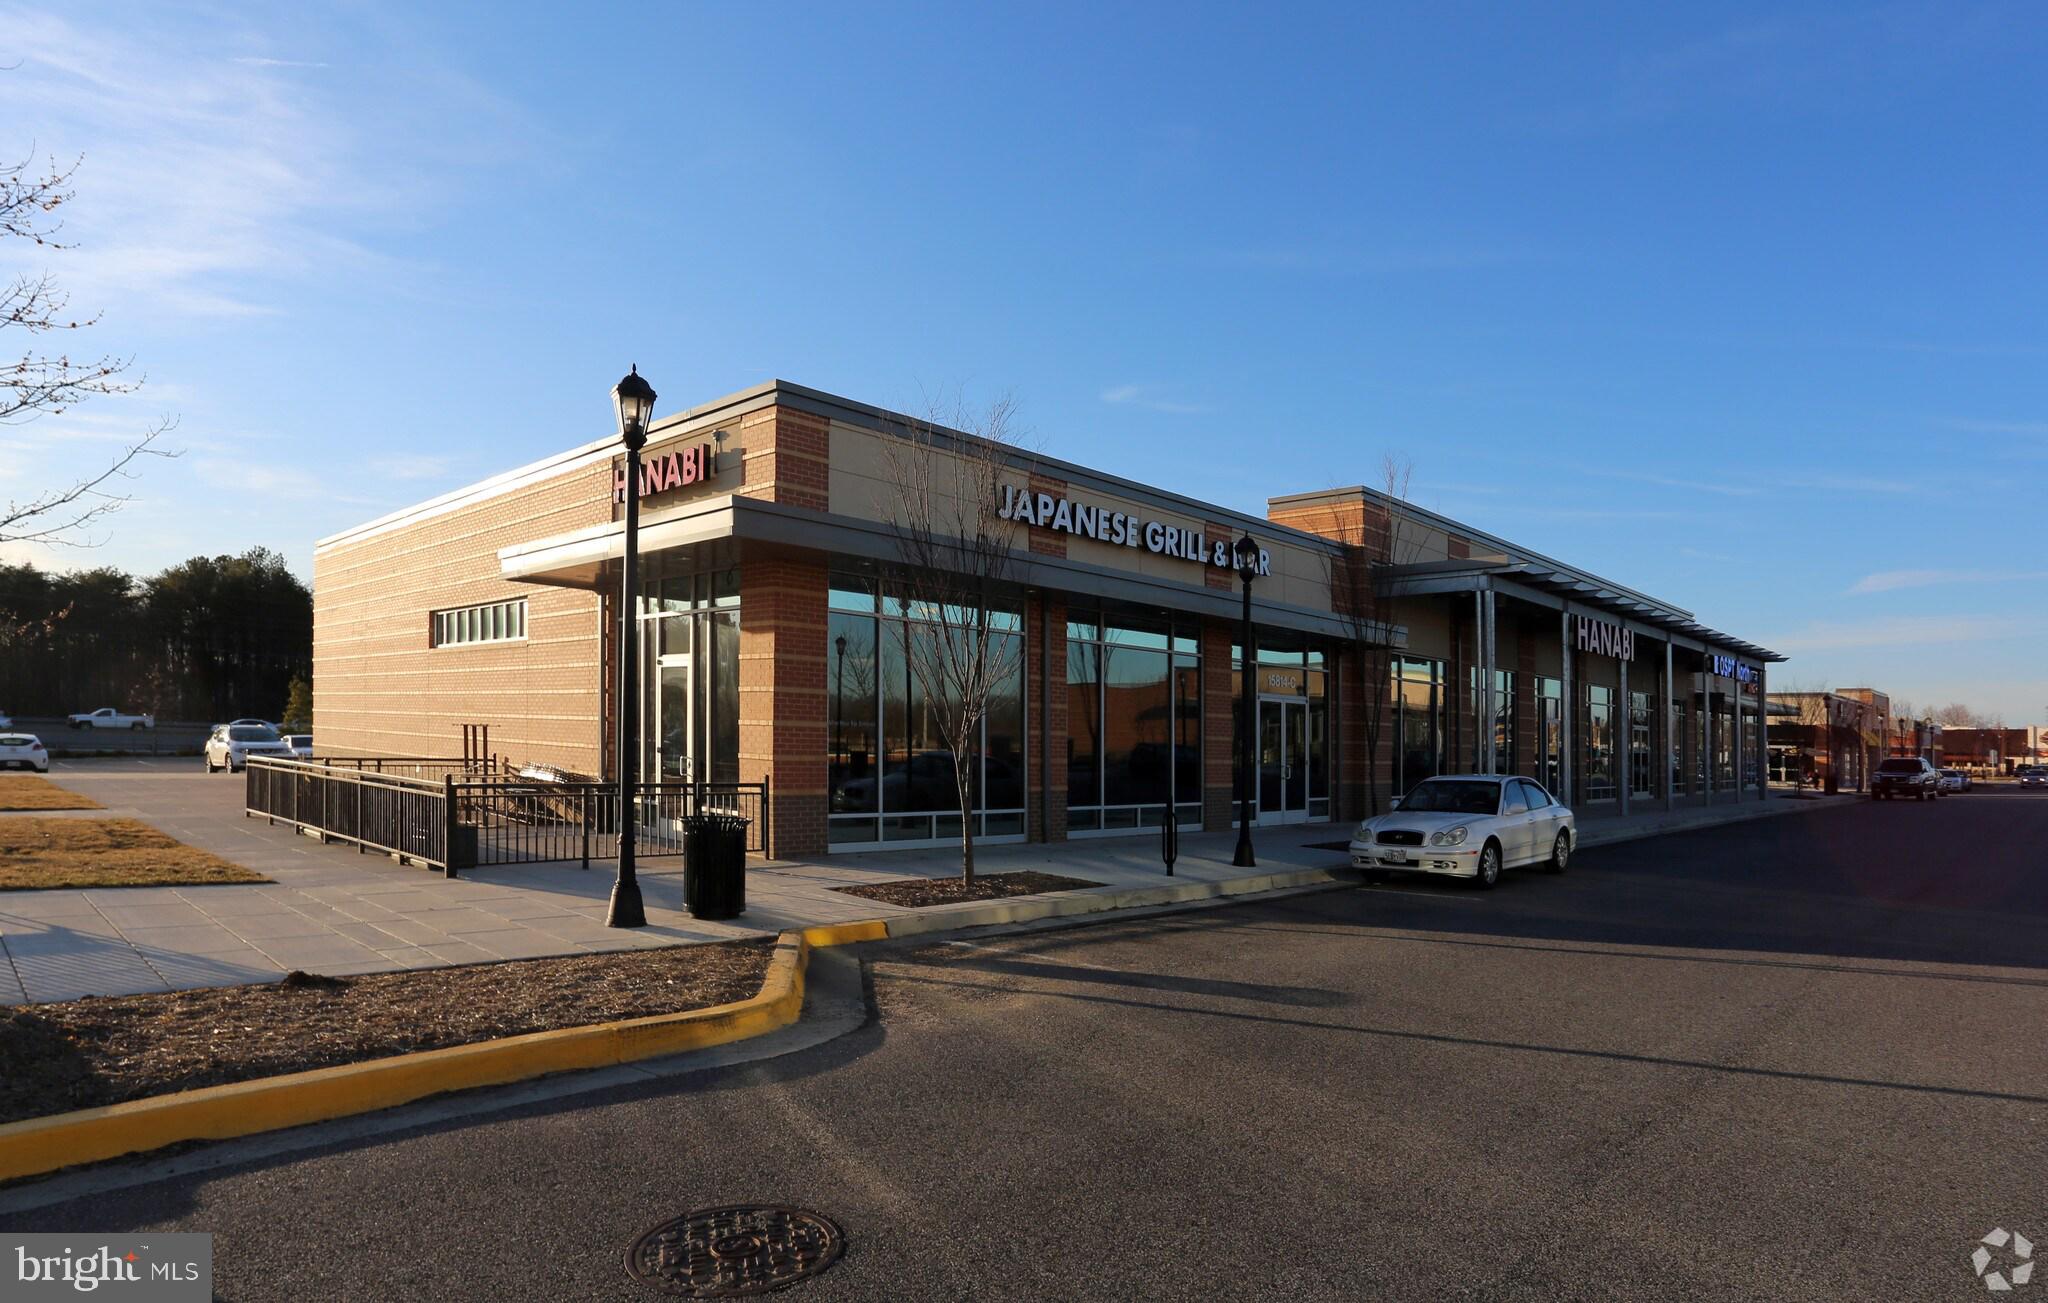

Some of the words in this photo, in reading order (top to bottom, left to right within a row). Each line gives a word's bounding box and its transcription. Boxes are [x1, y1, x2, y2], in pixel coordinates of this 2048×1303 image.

[998, 484, 1139, 548] JAPANESE
[1145, 520, 1209, 564] GRILL
[1213, 540, 1227, 568] &
[1577, 615, 1635, 662] HANABI
